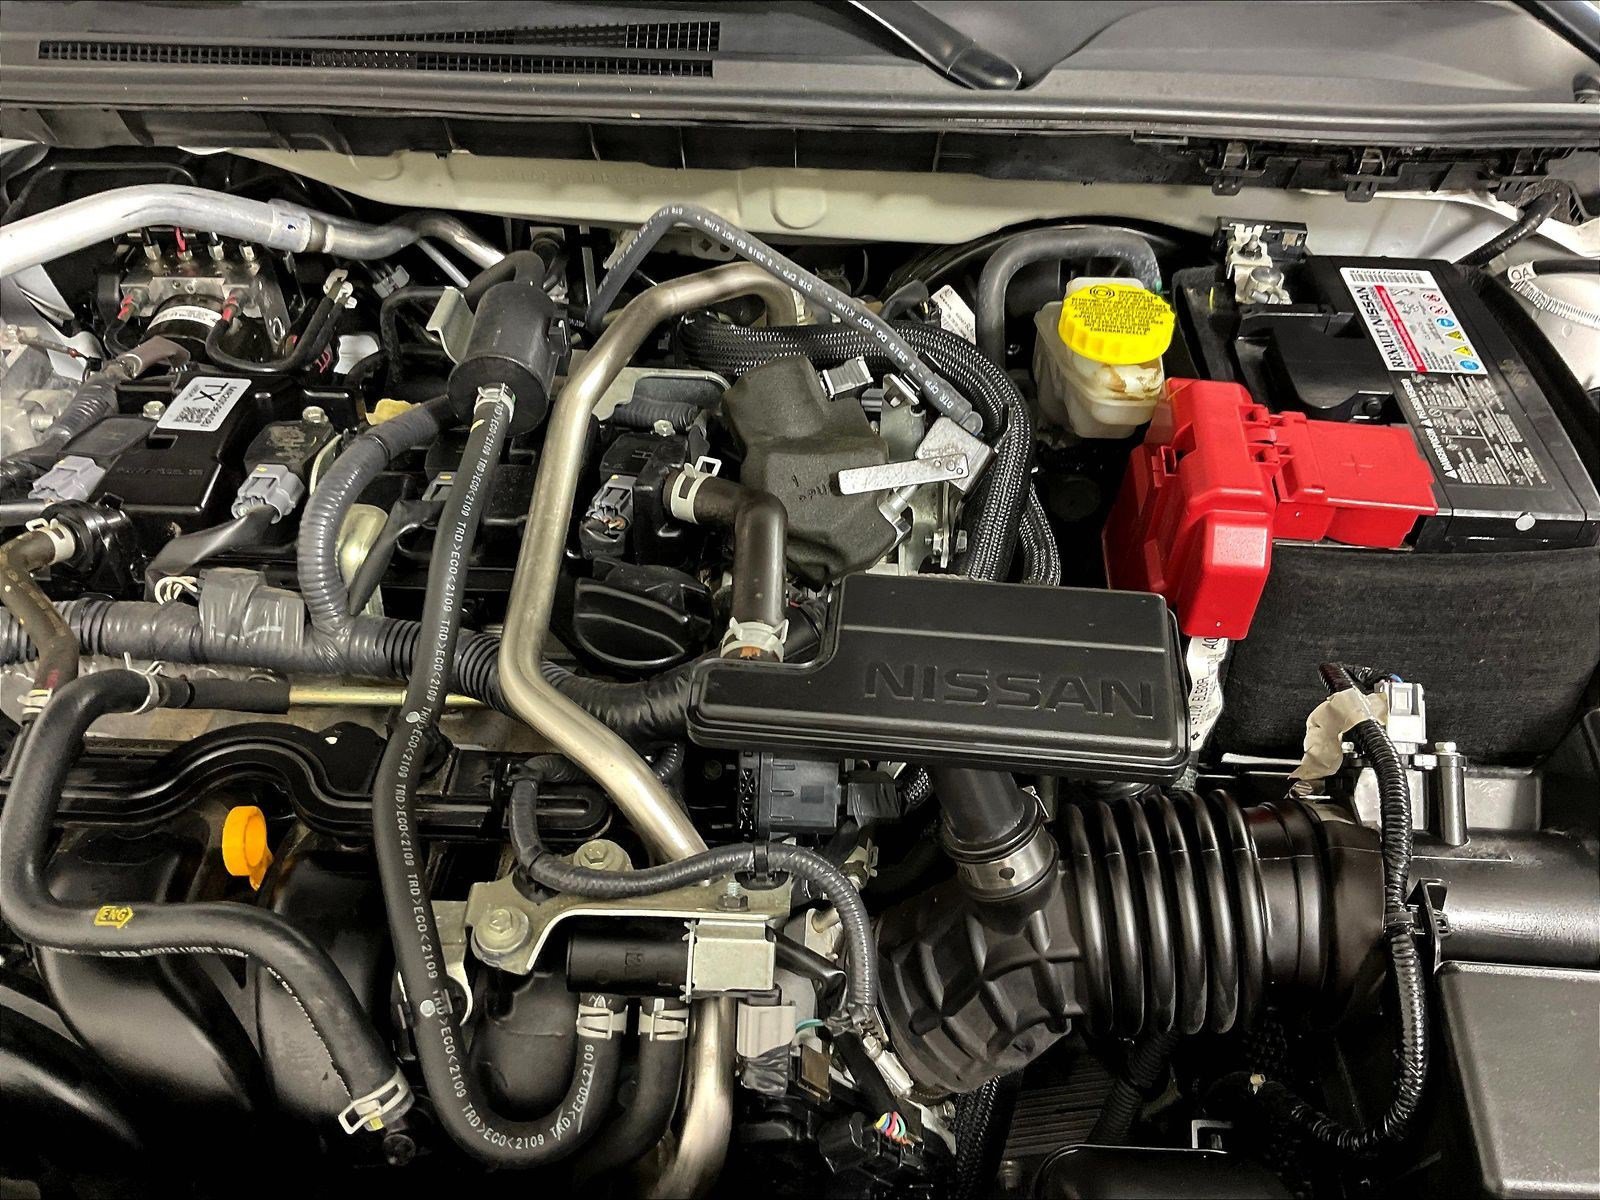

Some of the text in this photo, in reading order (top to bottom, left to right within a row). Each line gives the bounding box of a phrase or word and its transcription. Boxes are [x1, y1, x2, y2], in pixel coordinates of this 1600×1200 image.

[857, 315, 875, 332] NOT
[876, 329, 888, 344] DO
[1355, 286, 1385, 328] NISSAN
[192, 382, 230, 402] TX
[461, 456, 488, 517] TRD>ECO<2109
[443, 521, 467, 612] TRD>ECO<2109
[426, 620, 451, 702] TRD>ECO<2109
[863, 660, 1155, 720] NISSAN
[394, 783, 415, 867] TRD>ECO<2109
[99, 908, 128, 921] ENG
[407, 873, 438, 979] TRD>ECO<2109
[550, 1044, 595, 1140] TRD>ECO<2109
[461, 1102, 545, 1150] TRD>ECO<2109
